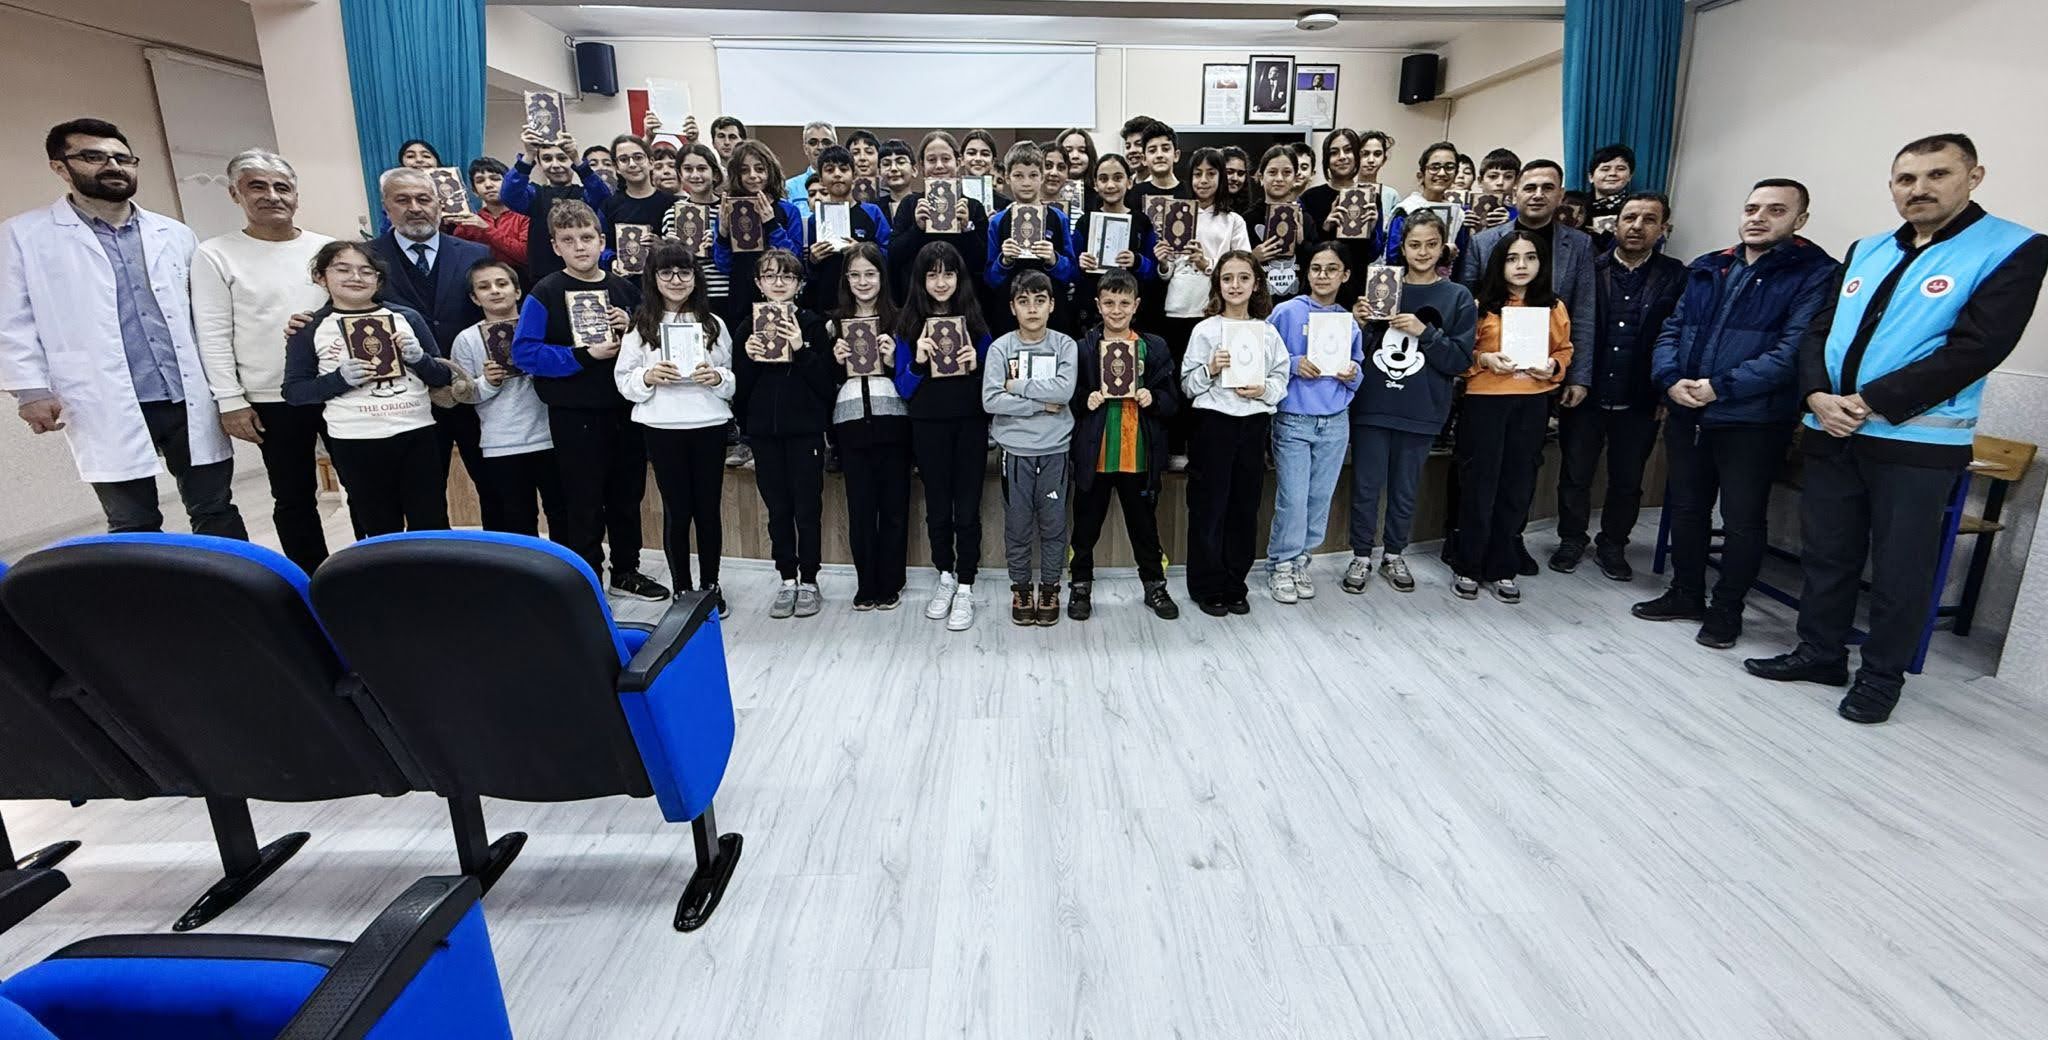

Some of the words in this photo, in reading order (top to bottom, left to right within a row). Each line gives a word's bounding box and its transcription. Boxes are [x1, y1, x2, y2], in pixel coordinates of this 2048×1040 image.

[328, 337, 345, 362] MIC
[359, 404, 378, 412] THE
[381, 400, 421, 411] ORIGIN
